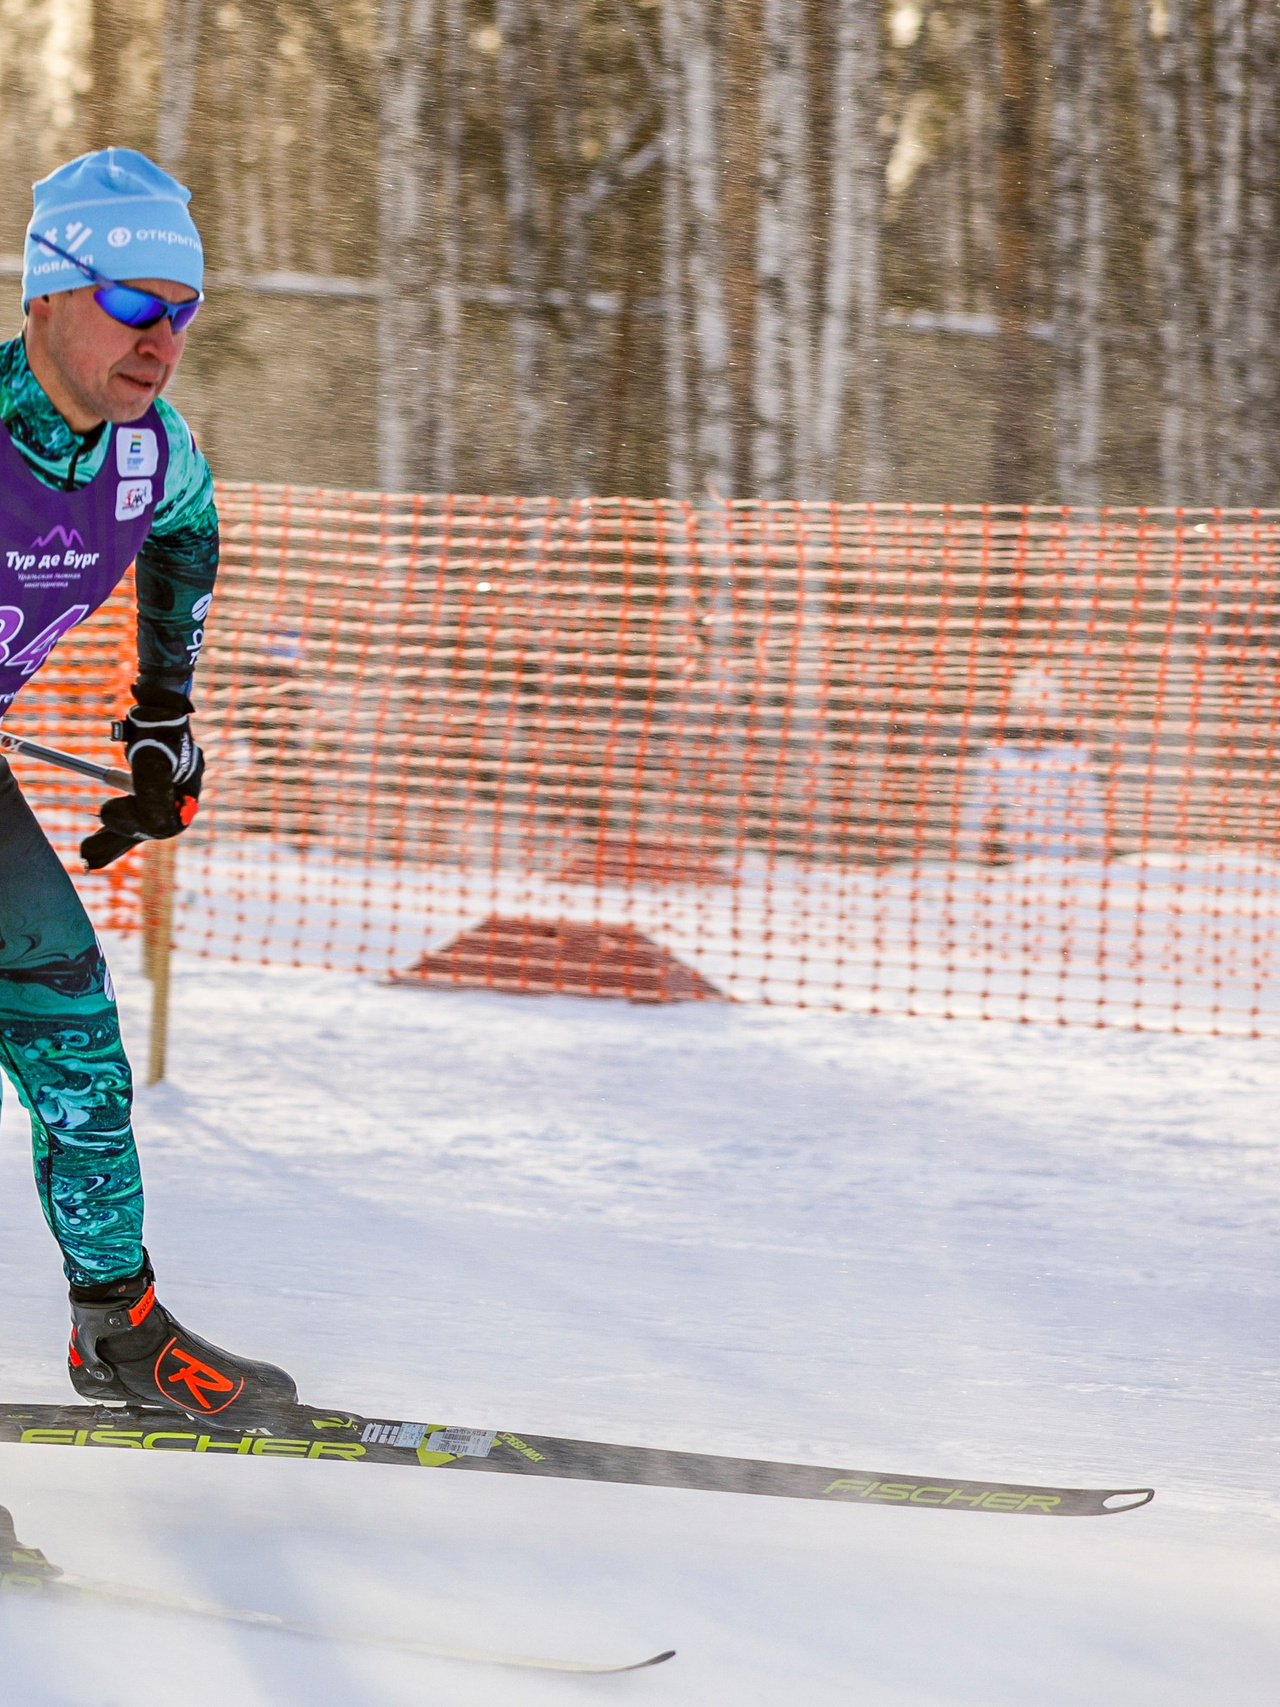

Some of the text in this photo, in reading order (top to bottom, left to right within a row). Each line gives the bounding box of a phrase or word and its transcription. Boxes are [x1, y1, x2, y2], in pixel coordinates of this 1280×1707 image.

[33, 254, 94, 276] UGRAKI
[6, 550, 100, 571] Тур де Бург
[20, 1428, 368, 1462] FISCHER
[822, 1478, 1062, 1513] FISCHER
